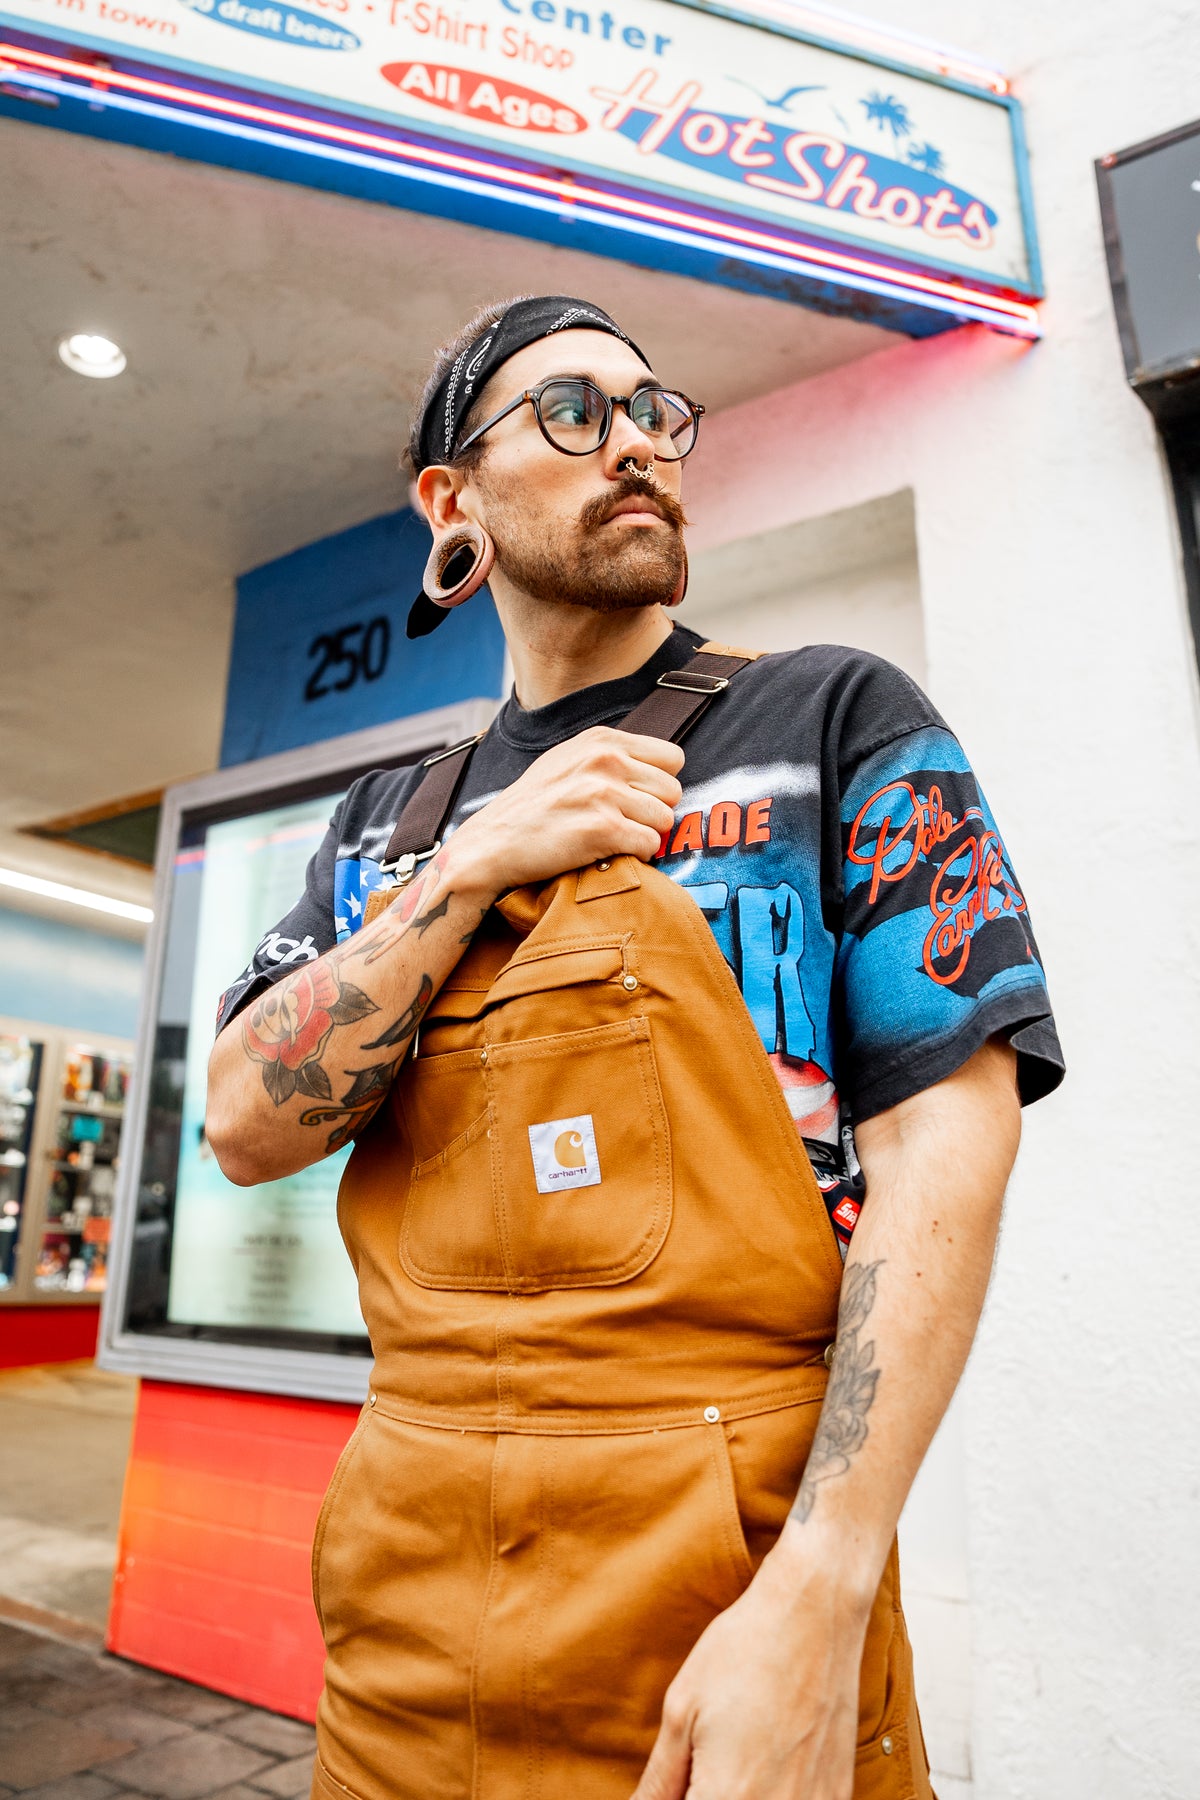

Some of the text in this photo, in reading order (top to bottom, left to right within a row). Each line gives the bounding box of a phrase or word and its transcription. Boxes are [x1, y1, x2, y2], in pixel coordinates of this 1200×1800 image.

[98, 2, 179, 36] town
[217, 0, 358, 50] draft beers
[500, 26, 576, 71] Shop
[397, 63, 579, 133] All Ages
[303, 615, 391, 703] 250
[655, 797, 774, 860] ADE
[547, 1167, 588, 1180] carhartt
[835, 1202, 858, 1227] Sna
